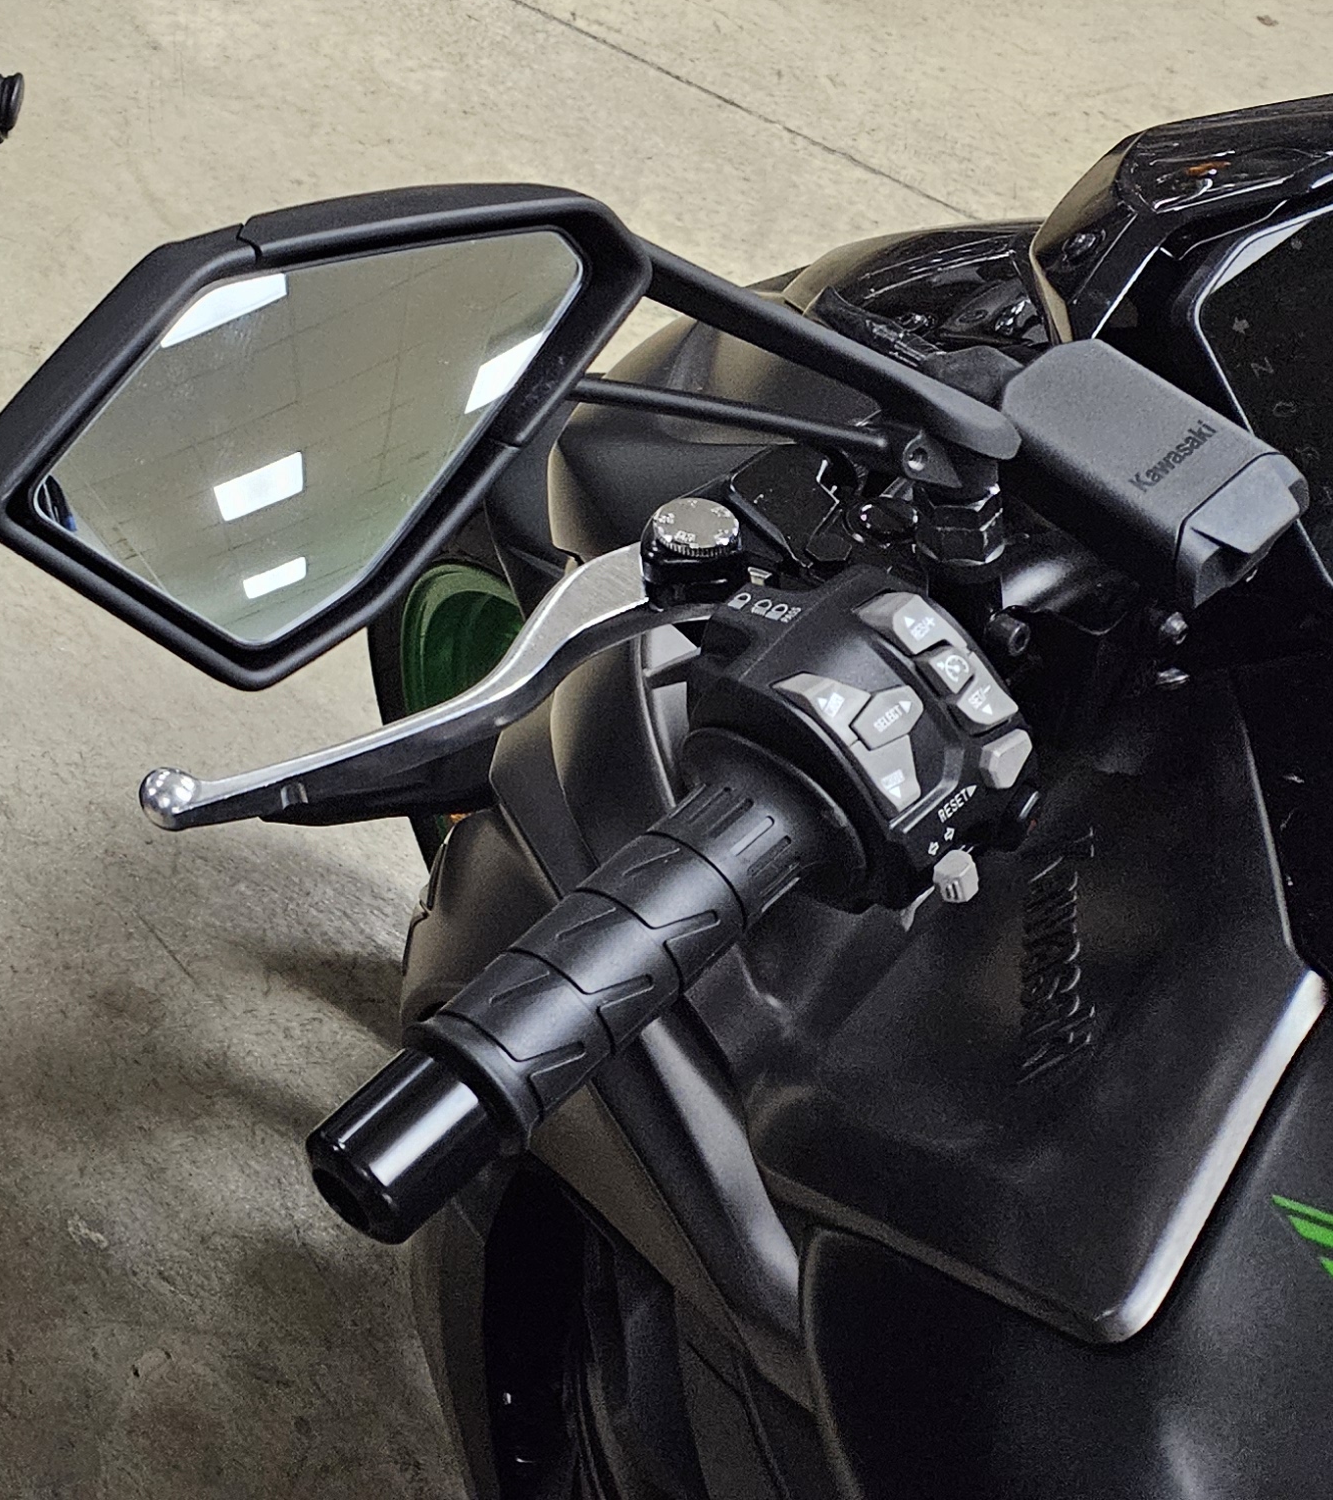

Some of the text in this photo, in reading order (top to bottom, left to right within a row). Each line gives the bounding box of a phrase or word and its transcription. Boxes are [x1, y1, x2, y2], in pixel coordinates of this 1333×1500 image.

[1128, 419, 1217, 493] Kawasaki
[873, 704, 905, 733] SELECT
[938, 788, 968, 823] RESET
